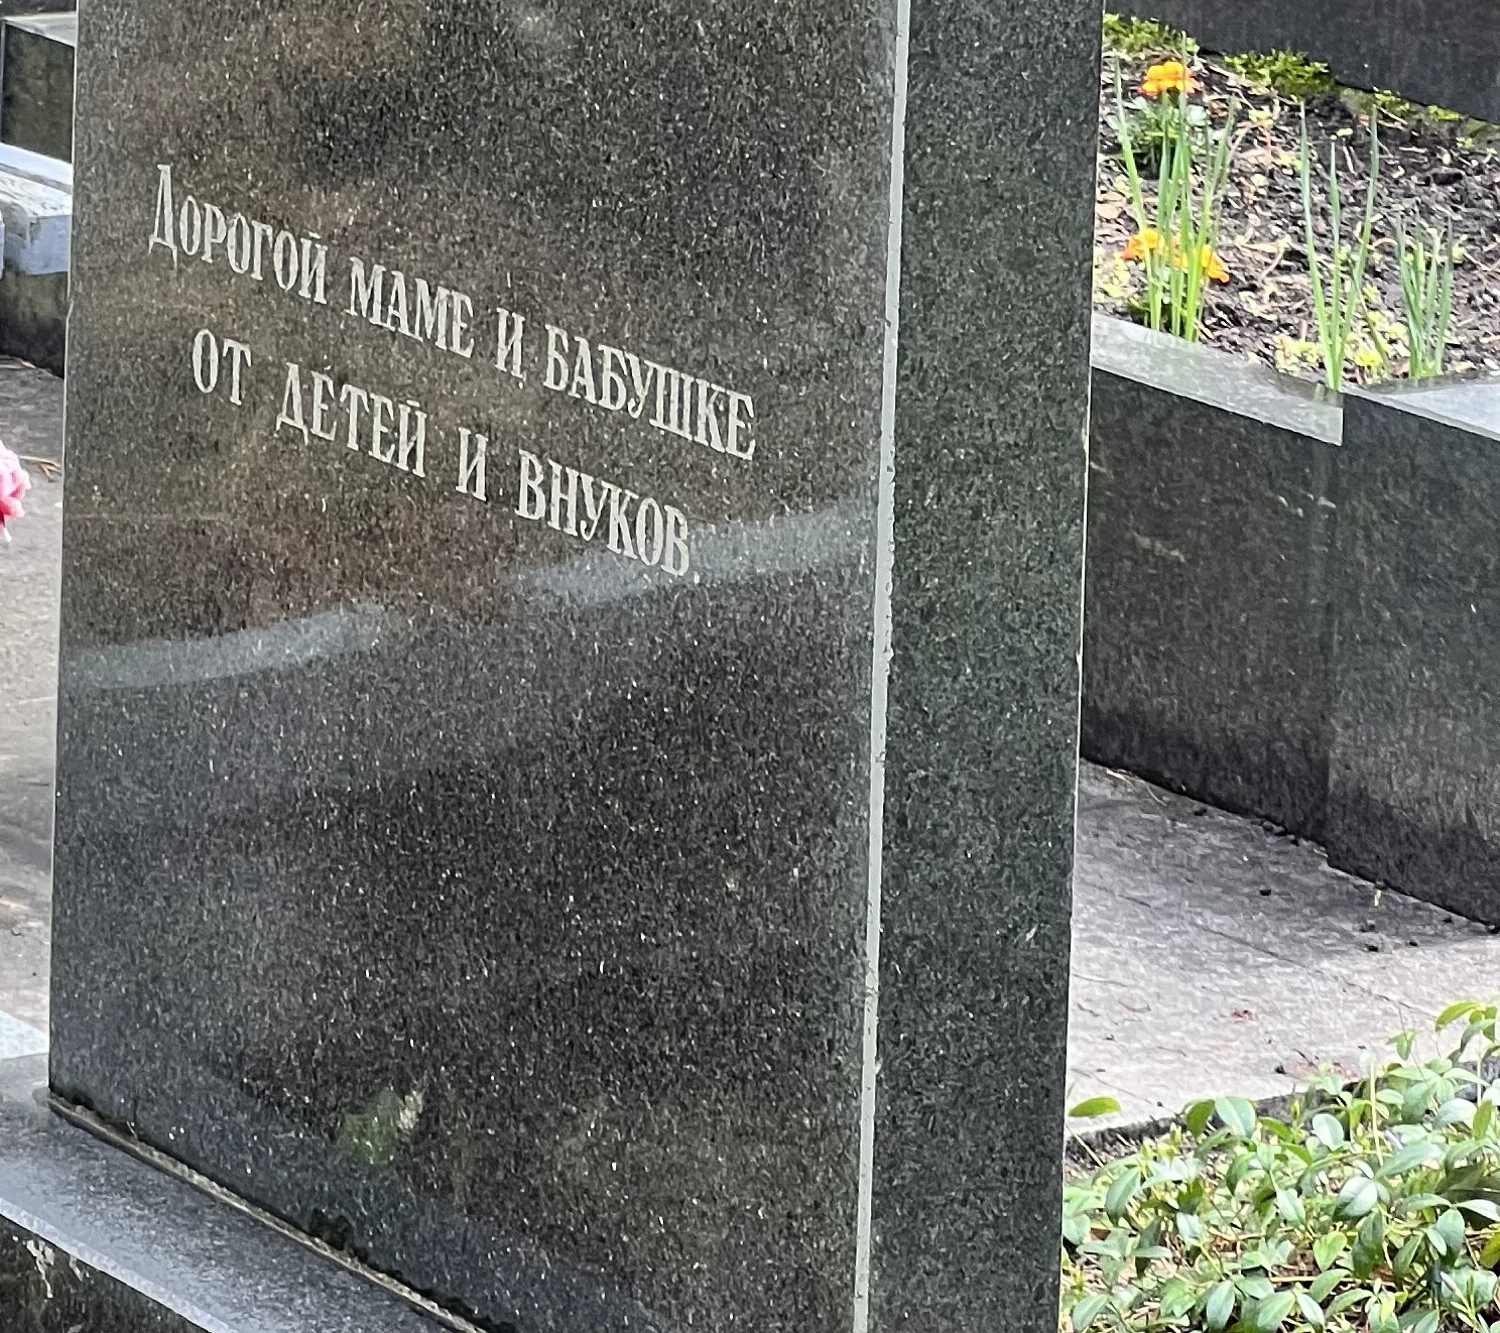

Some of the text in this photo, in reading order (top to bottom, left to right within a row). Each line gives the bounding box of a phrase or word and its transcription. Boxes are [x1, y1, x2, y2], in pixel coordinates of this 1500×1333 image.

[147, 163, 757, 461] ДОРОГОЙ МАМЕ И БАБУШКЕ
[191, 328, 691, 578] ОТ ДЕТЕЙ И ВНУКОВ
